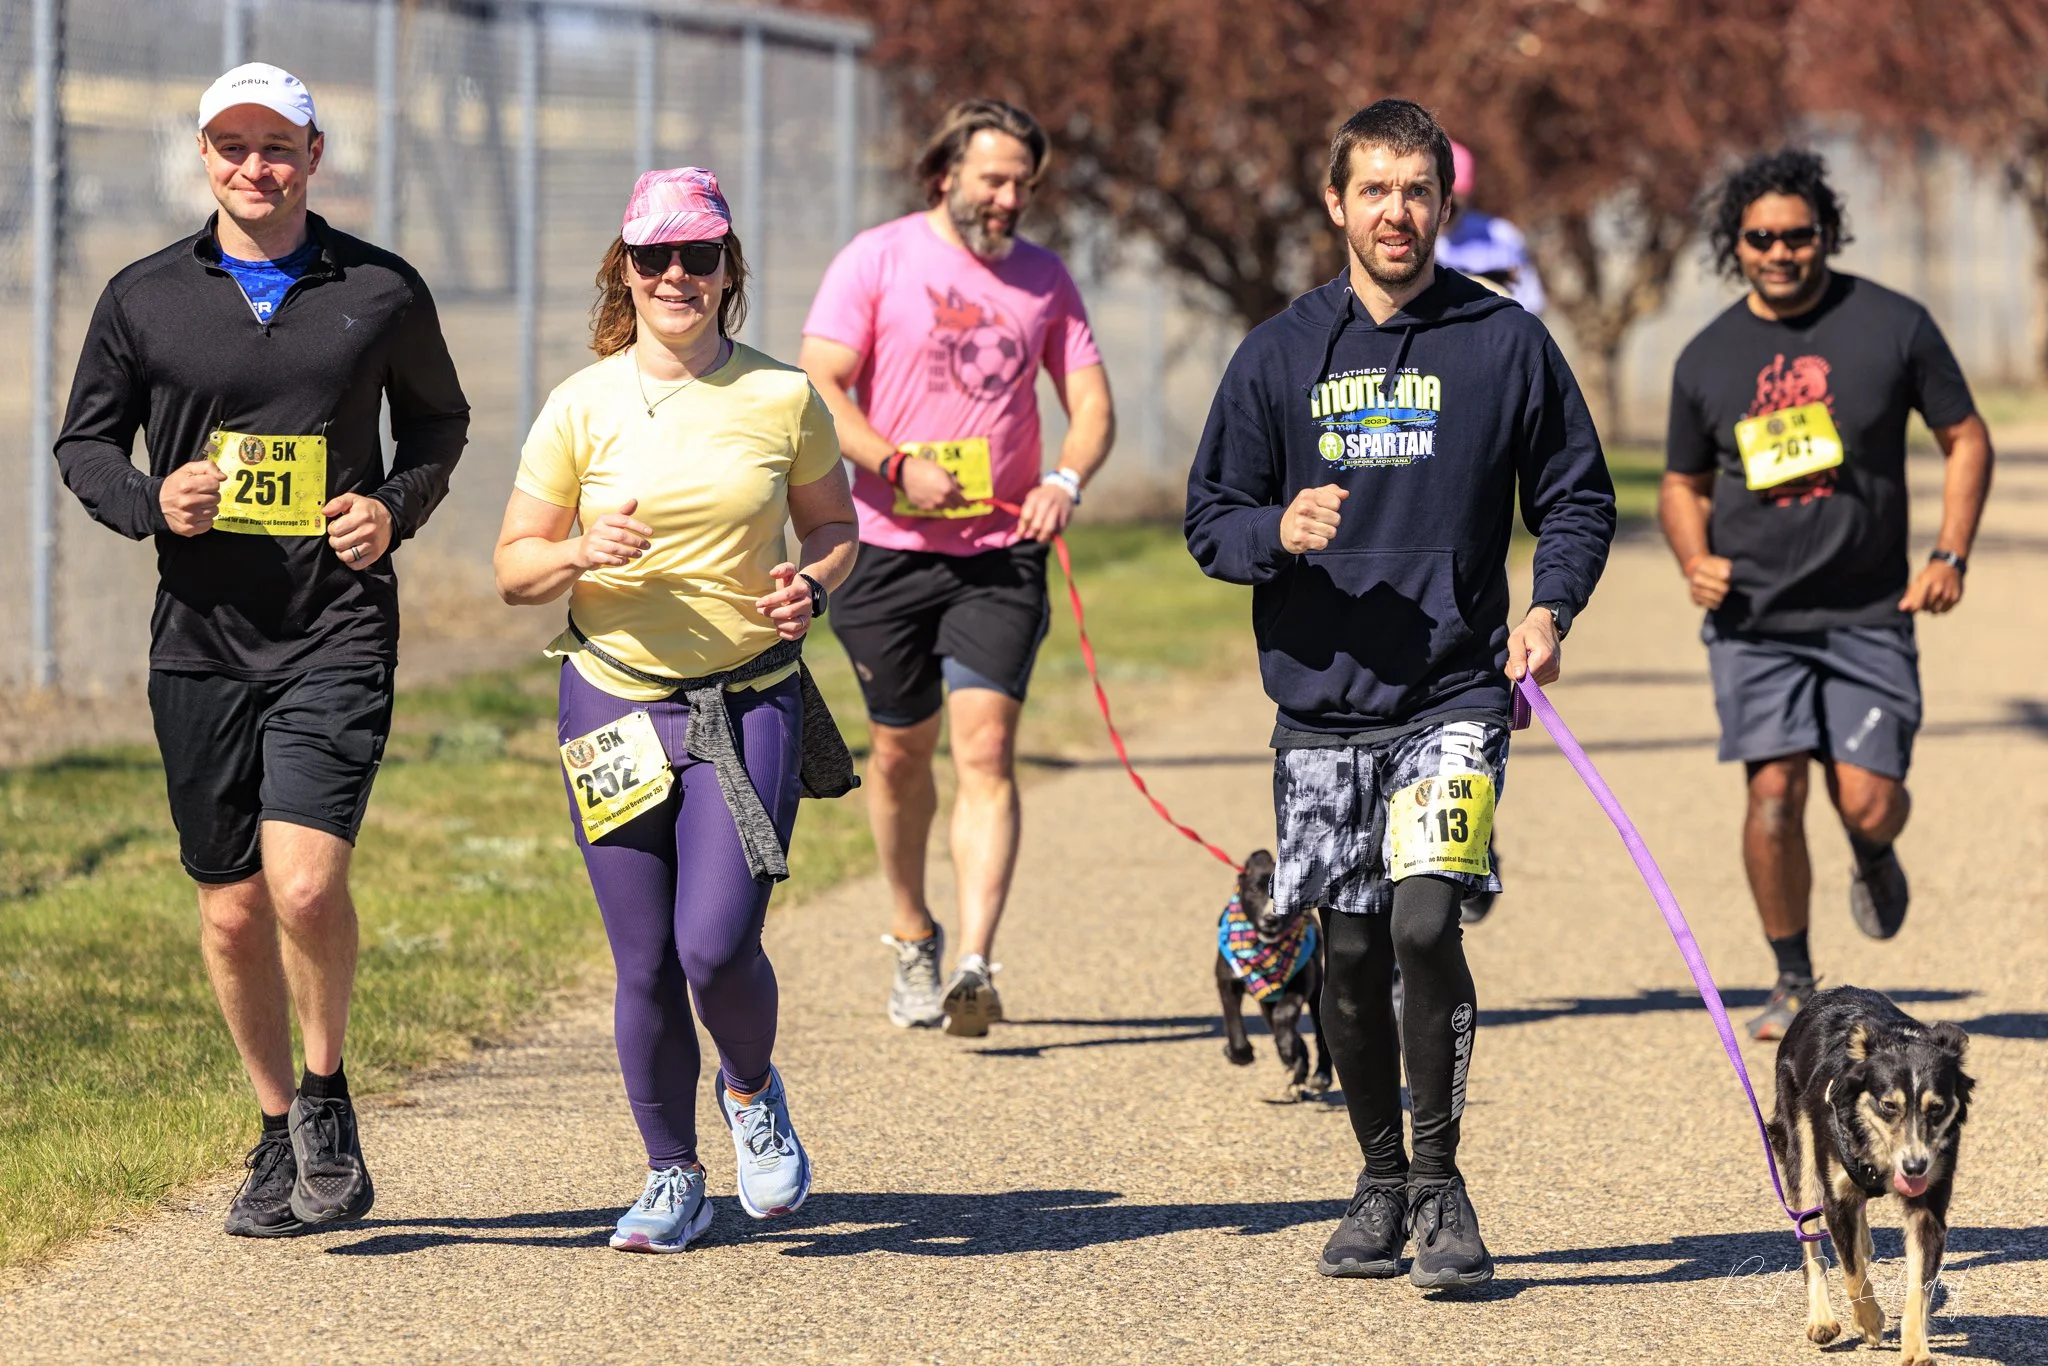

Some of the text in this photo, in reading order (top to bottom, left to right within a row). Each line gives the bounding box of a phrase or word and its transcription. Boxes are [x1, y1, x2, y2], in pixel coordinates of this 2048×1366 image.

[232, 78, 269, 88] KIPRUN
[1328, 367, 1419, 380] FLATHEAD AKE
[272, 441, 296, 462] 5K
[1345, 430, 1433, 458] SPARTAN
[235, 469, 291, 506] 251
[273, 519, 298, 527] Beverage
[596, 726, 625, 753] 5K
[576, 755, 640, 809] 252
[1448, 779, 1473, 800] 5K
[611, 804, 631, 819] Atypical
[629, 792, 654, 808] Beverage
[653, 785, 664, 795] 252
[1417, 808, 1468, 844] 113
[1403, 859, 1416, 869] Good
[1450, 1029, 1472, 1122] SPARTAN
